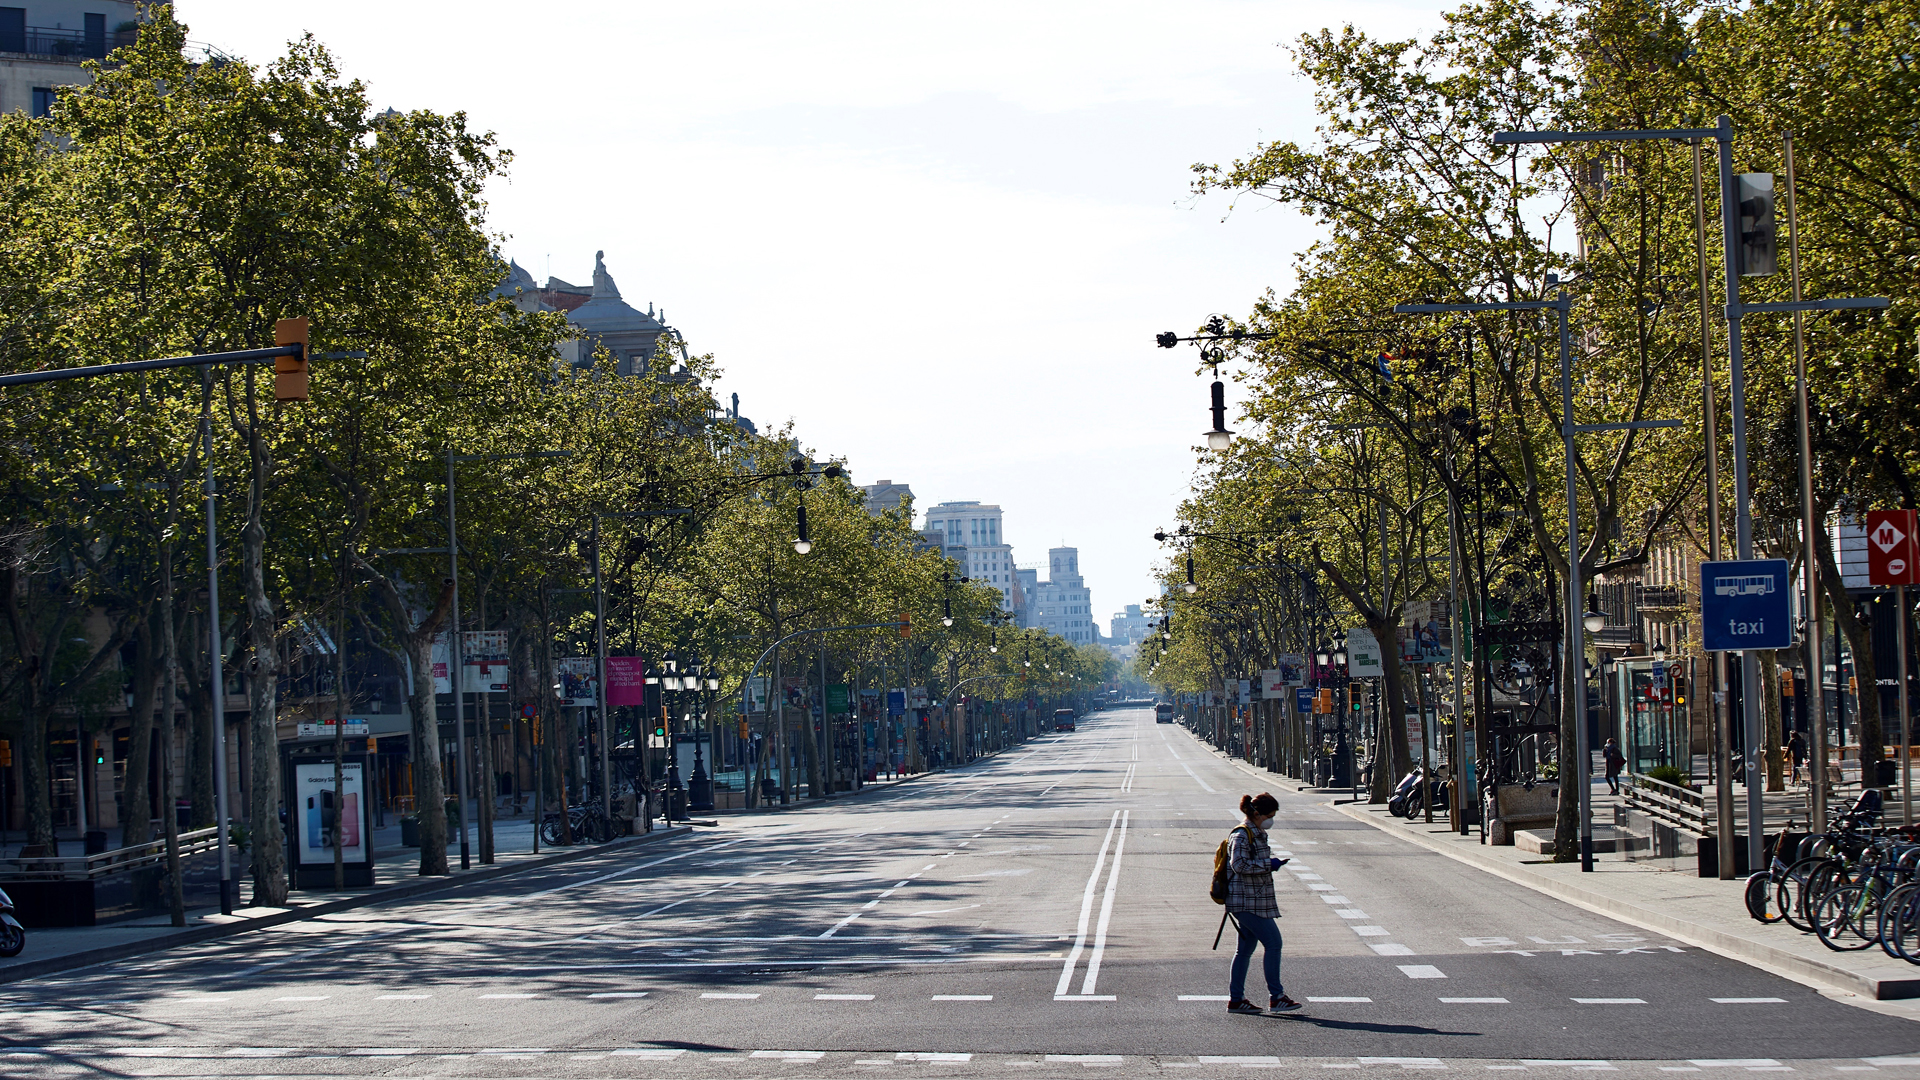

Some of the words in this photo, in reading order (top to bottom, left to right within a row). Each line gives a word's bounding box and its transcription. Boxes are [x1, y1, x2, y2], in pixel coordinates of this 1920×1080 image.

[1879, 528, 1894, 545] M
[1729, 618, 1764, 635] taxi
[317, 827, 352, 847] 5G
[1459, 933, 1653, 947] BUS
[1493, 945, 1687, 957] TAXI
